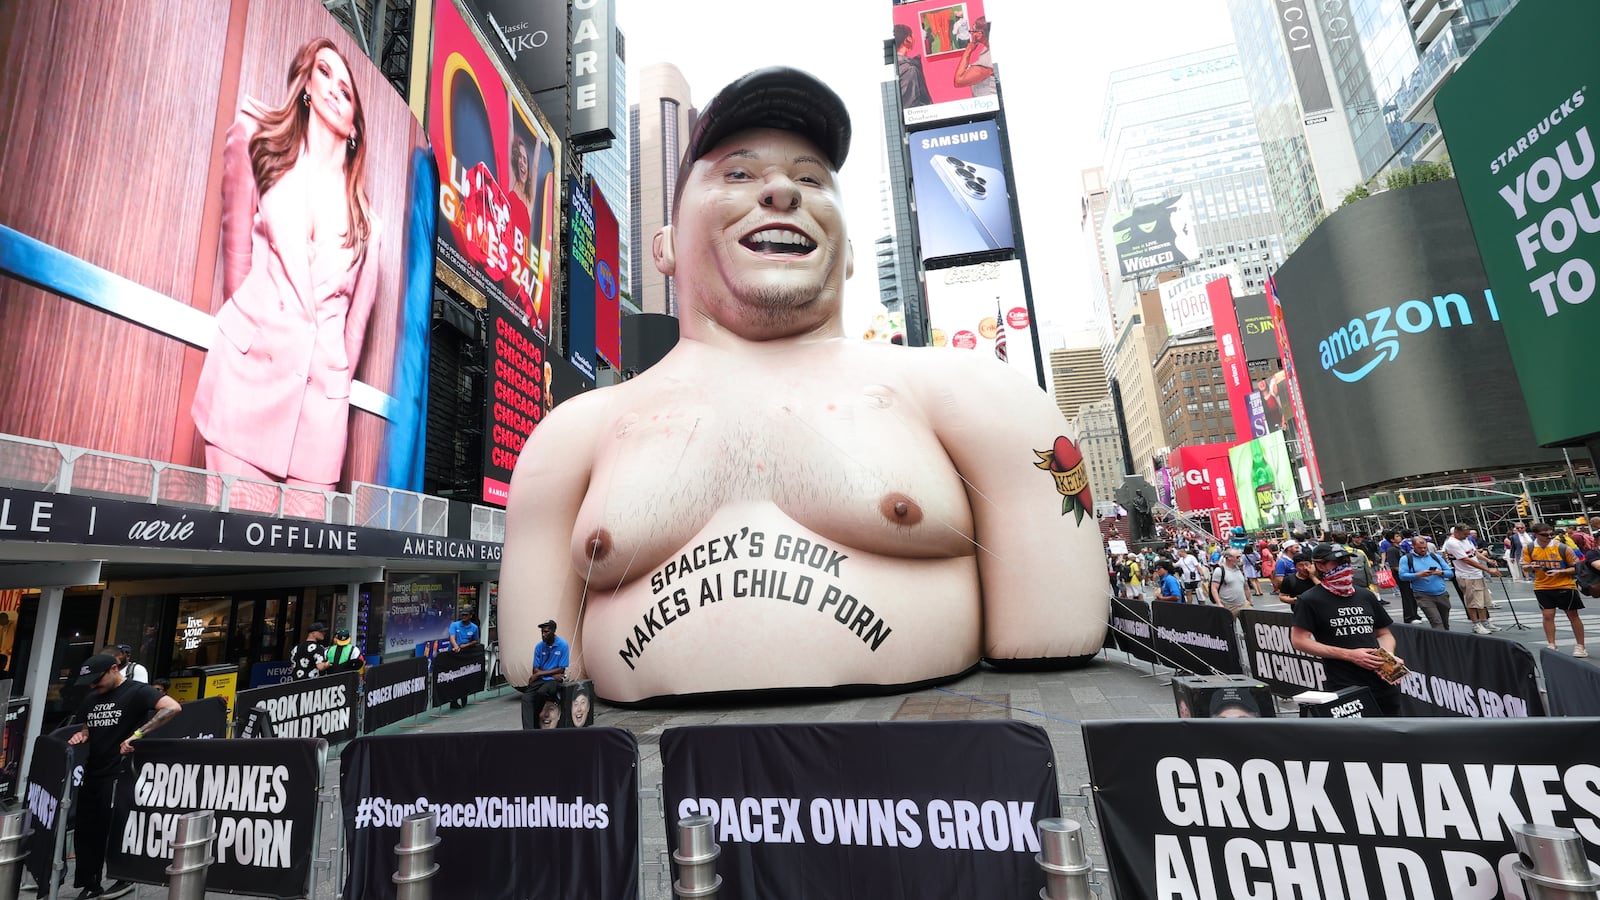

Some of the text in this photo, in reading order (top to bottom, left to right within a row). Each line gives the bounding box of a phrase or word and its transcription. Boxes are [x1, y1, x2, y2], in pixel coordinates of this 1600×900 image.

[921, 130, 988, 149] SAMSUNG
[1490, 89, 1586, 175] STARBUCKS
[1498, 126, 1596, 221] YOU
[1168, 275, 1203, 300] LITTLE
[1529, 258, 1596, 317] TO
[495, 316, 542, 365] CHICAGO
[1318, 292, 1473, 370] amazon
[495, 337, 542, 383] CHICAGO
[494, 359, 541, 402] CHICAGO
[494, 380, 541, 421] CHICAGO
[128, 514, 194, 542] aerie
[246, 522, 357, 551] OFFLINE
[402, 537, 475, 559] AMERICAN
[651, 527, 849, 595] SPACEX'S GROK
[392, 582, 411, 593] Target
[186, 616, 203, 628] live
[618, 569, 892, 670] MAKES AI CHILD PORN
[1337, 606, 1364, 617] STOP
[182, 626, 205, 640] your
[185, 637, 202, 650] life
[1254, 622, 1293, 653] GROK
[1335, 627, 1348, 636] AI
[266, 667, 293, 677] NEWS
[1256, 651, 1273, 679] AI
[1272, 652, 1315, 687] CHILD
[93, 702, 115, 712] STOP
[300, 684, 347, 716] MAKES
[367, 686, 392, 708] SPACEX
[392, 680, 410, 698] OWNS
[1330, 699, 1363, 718] SPACEX'S
[1430, 676, 1479, 718] OWNS
[87, 709, 122, 720] PACEX'S
[94, 718, 119, 727] PORN
[312, 706, 351, 738] PORN
[135, 762, 200, 808] GROK
[202, 764, 290, 814] MAKES
[1156, 756, 1347, 834] GROK
[121, 810, 146, 856] AI
[217, 816, 294, 868] PORN
[810, 797, 923, 849] OWNS
[927, 799, 1042, 853] GROK
[1154, 834, 1222, 900] AI
